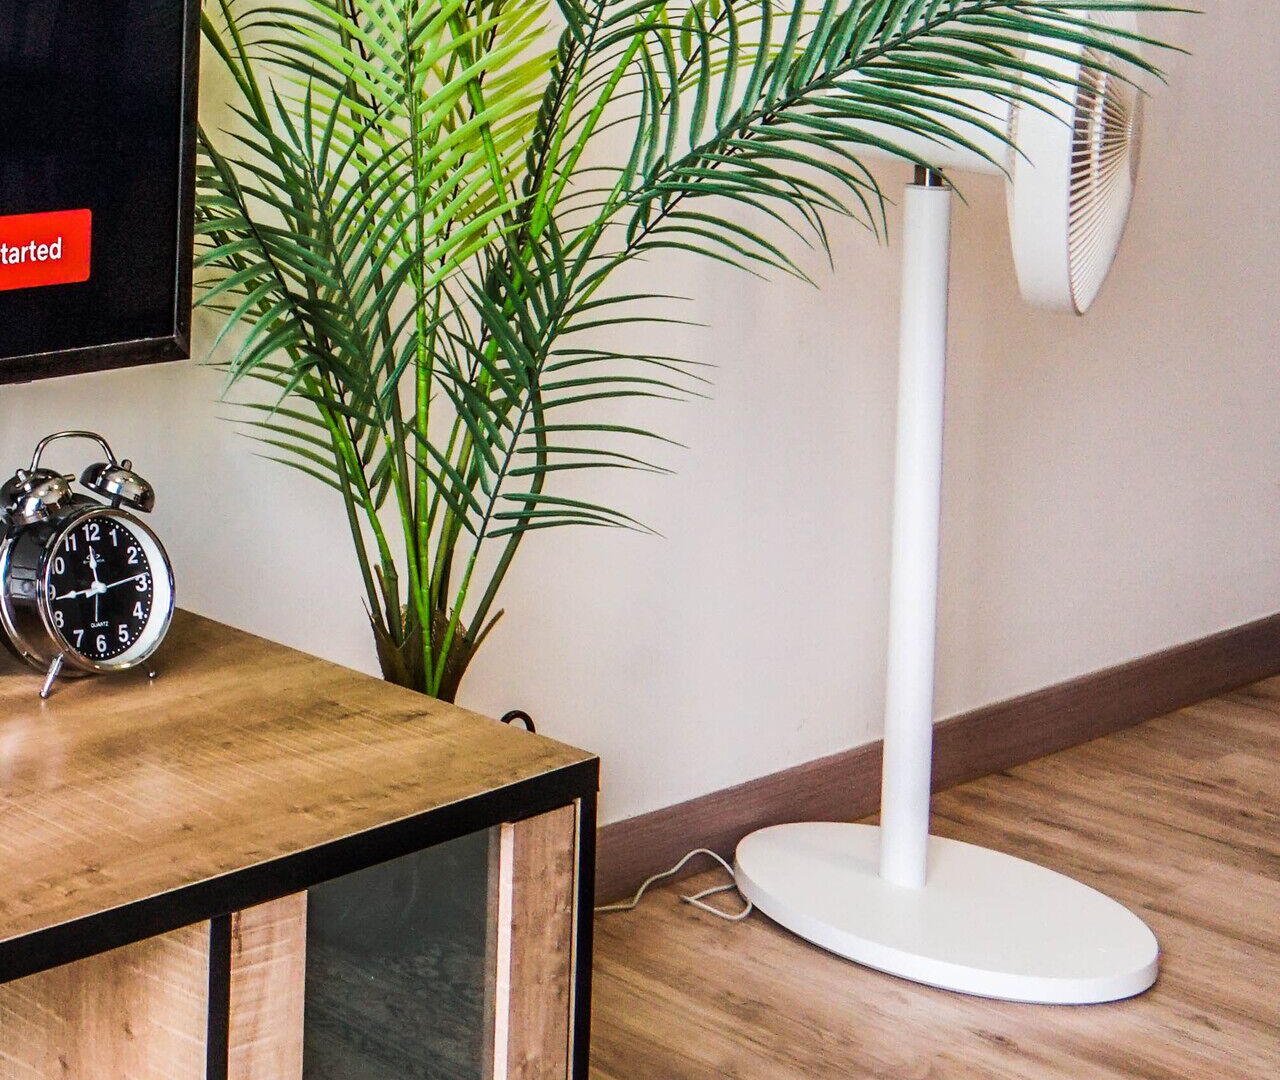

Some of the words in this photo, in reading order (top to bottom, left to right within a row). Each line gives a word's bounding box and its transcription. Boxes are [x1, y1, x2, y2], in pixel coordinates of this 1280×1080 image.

[82, 522, 101, 542] 12
[109, 528, 118, 547] 1
[64, 533, 77, 552] 11
[127, 546, 139, 565] 2
[135, 575, 148, 592] 3
[54, 610, 65, 628] 8
[133, 601, 144, 620] 4
[73, 629, 84, 648] 7
[118, 623, 129, 643] 5
[96, 634, 107, 653] 6
